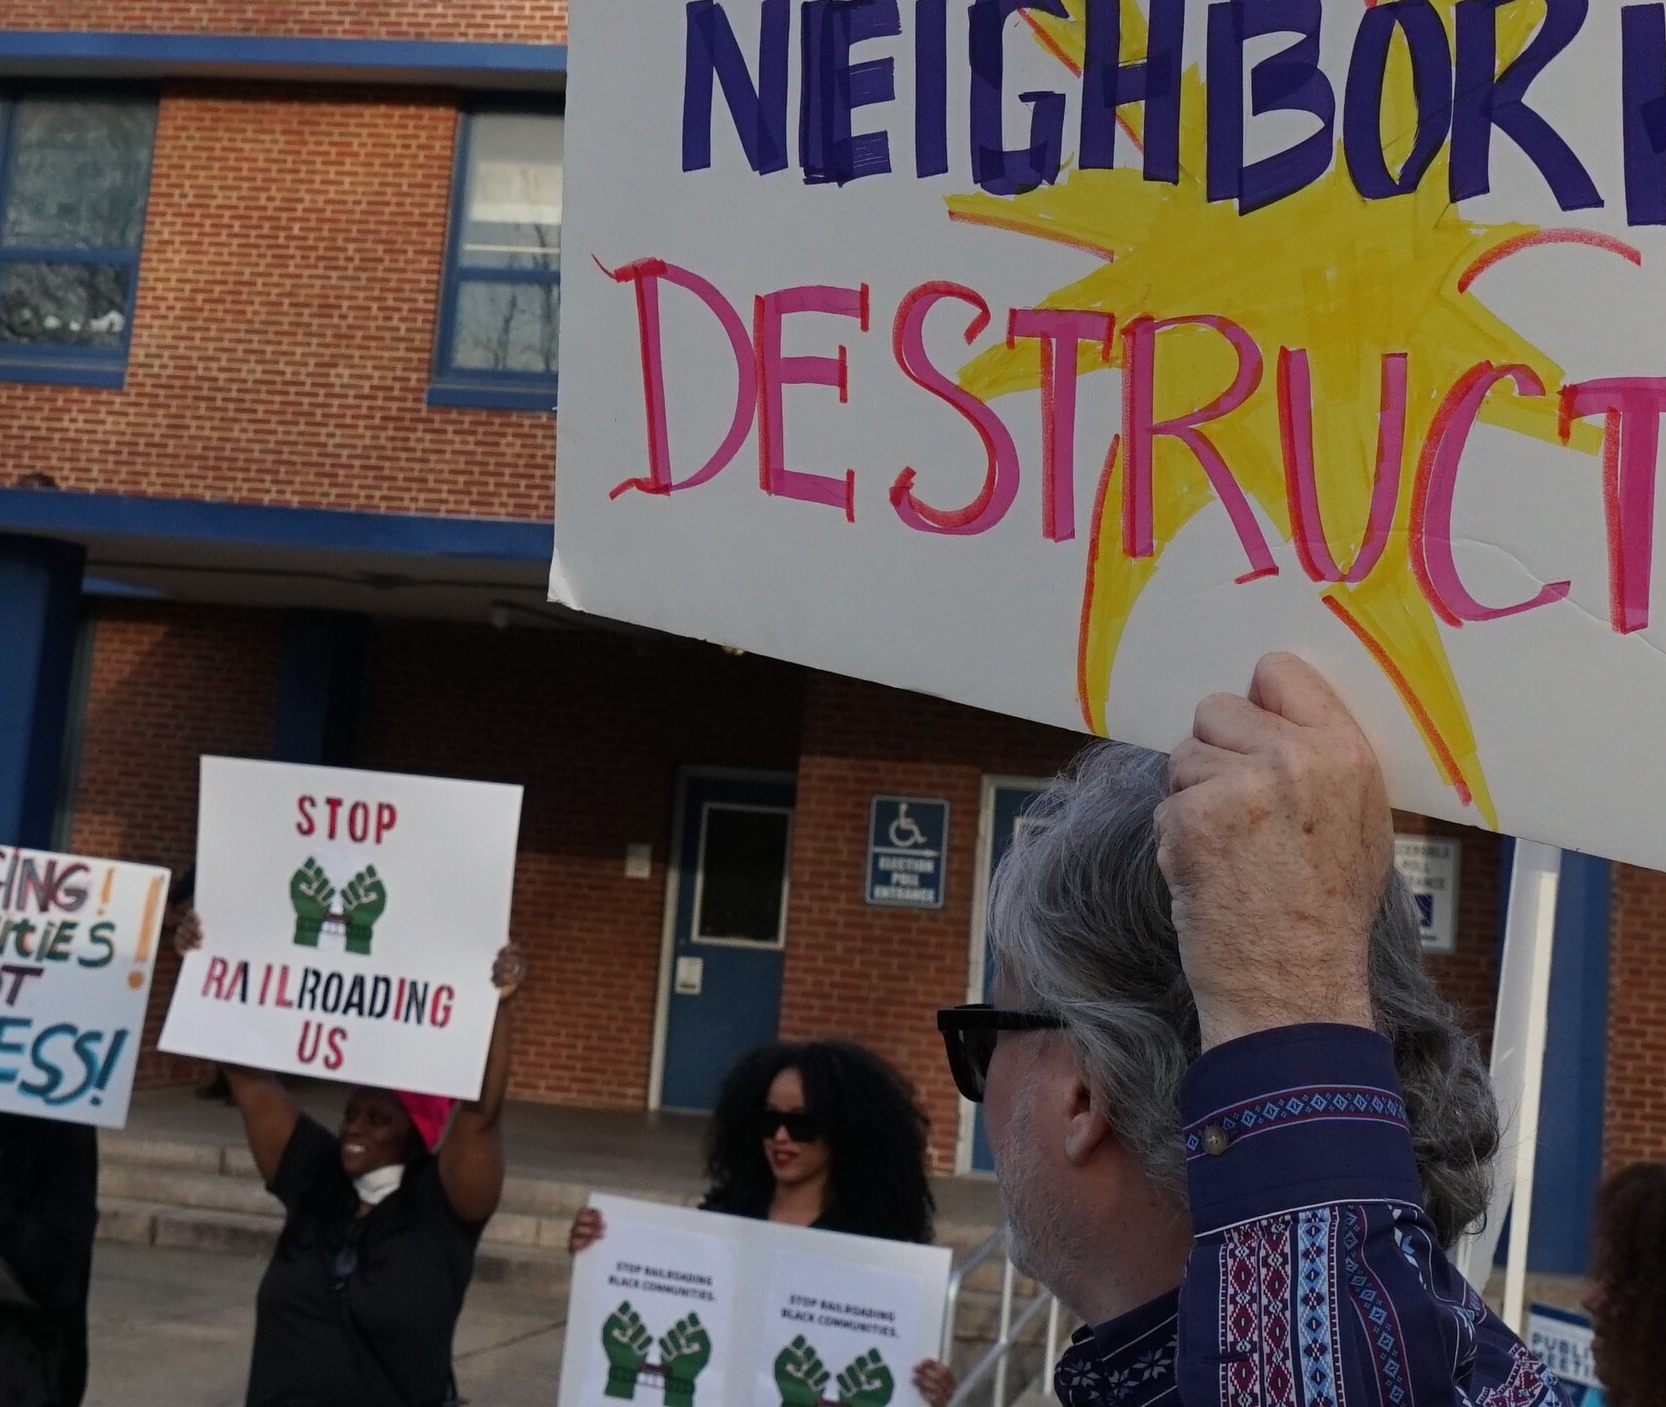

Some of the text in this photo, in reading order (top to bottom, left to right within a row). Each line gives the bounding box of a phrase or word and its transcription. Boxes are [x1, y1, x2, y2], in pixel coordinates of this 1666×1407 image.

[295, 793, 398, 846] STOP
[201, 955, 455, 1029] RAILROADING
[296, 1019, 349, 1072] US
[607, 1274, 639, 1289] BLACK
[616, 1261, 713, 1286] STOP RAILROADING
[780, 1306, 815, 1322] BLACK
[790, 1294, 896, 1323] STOP RAILROADING
[1532, 1331, 1590, 1361] PUBLI
